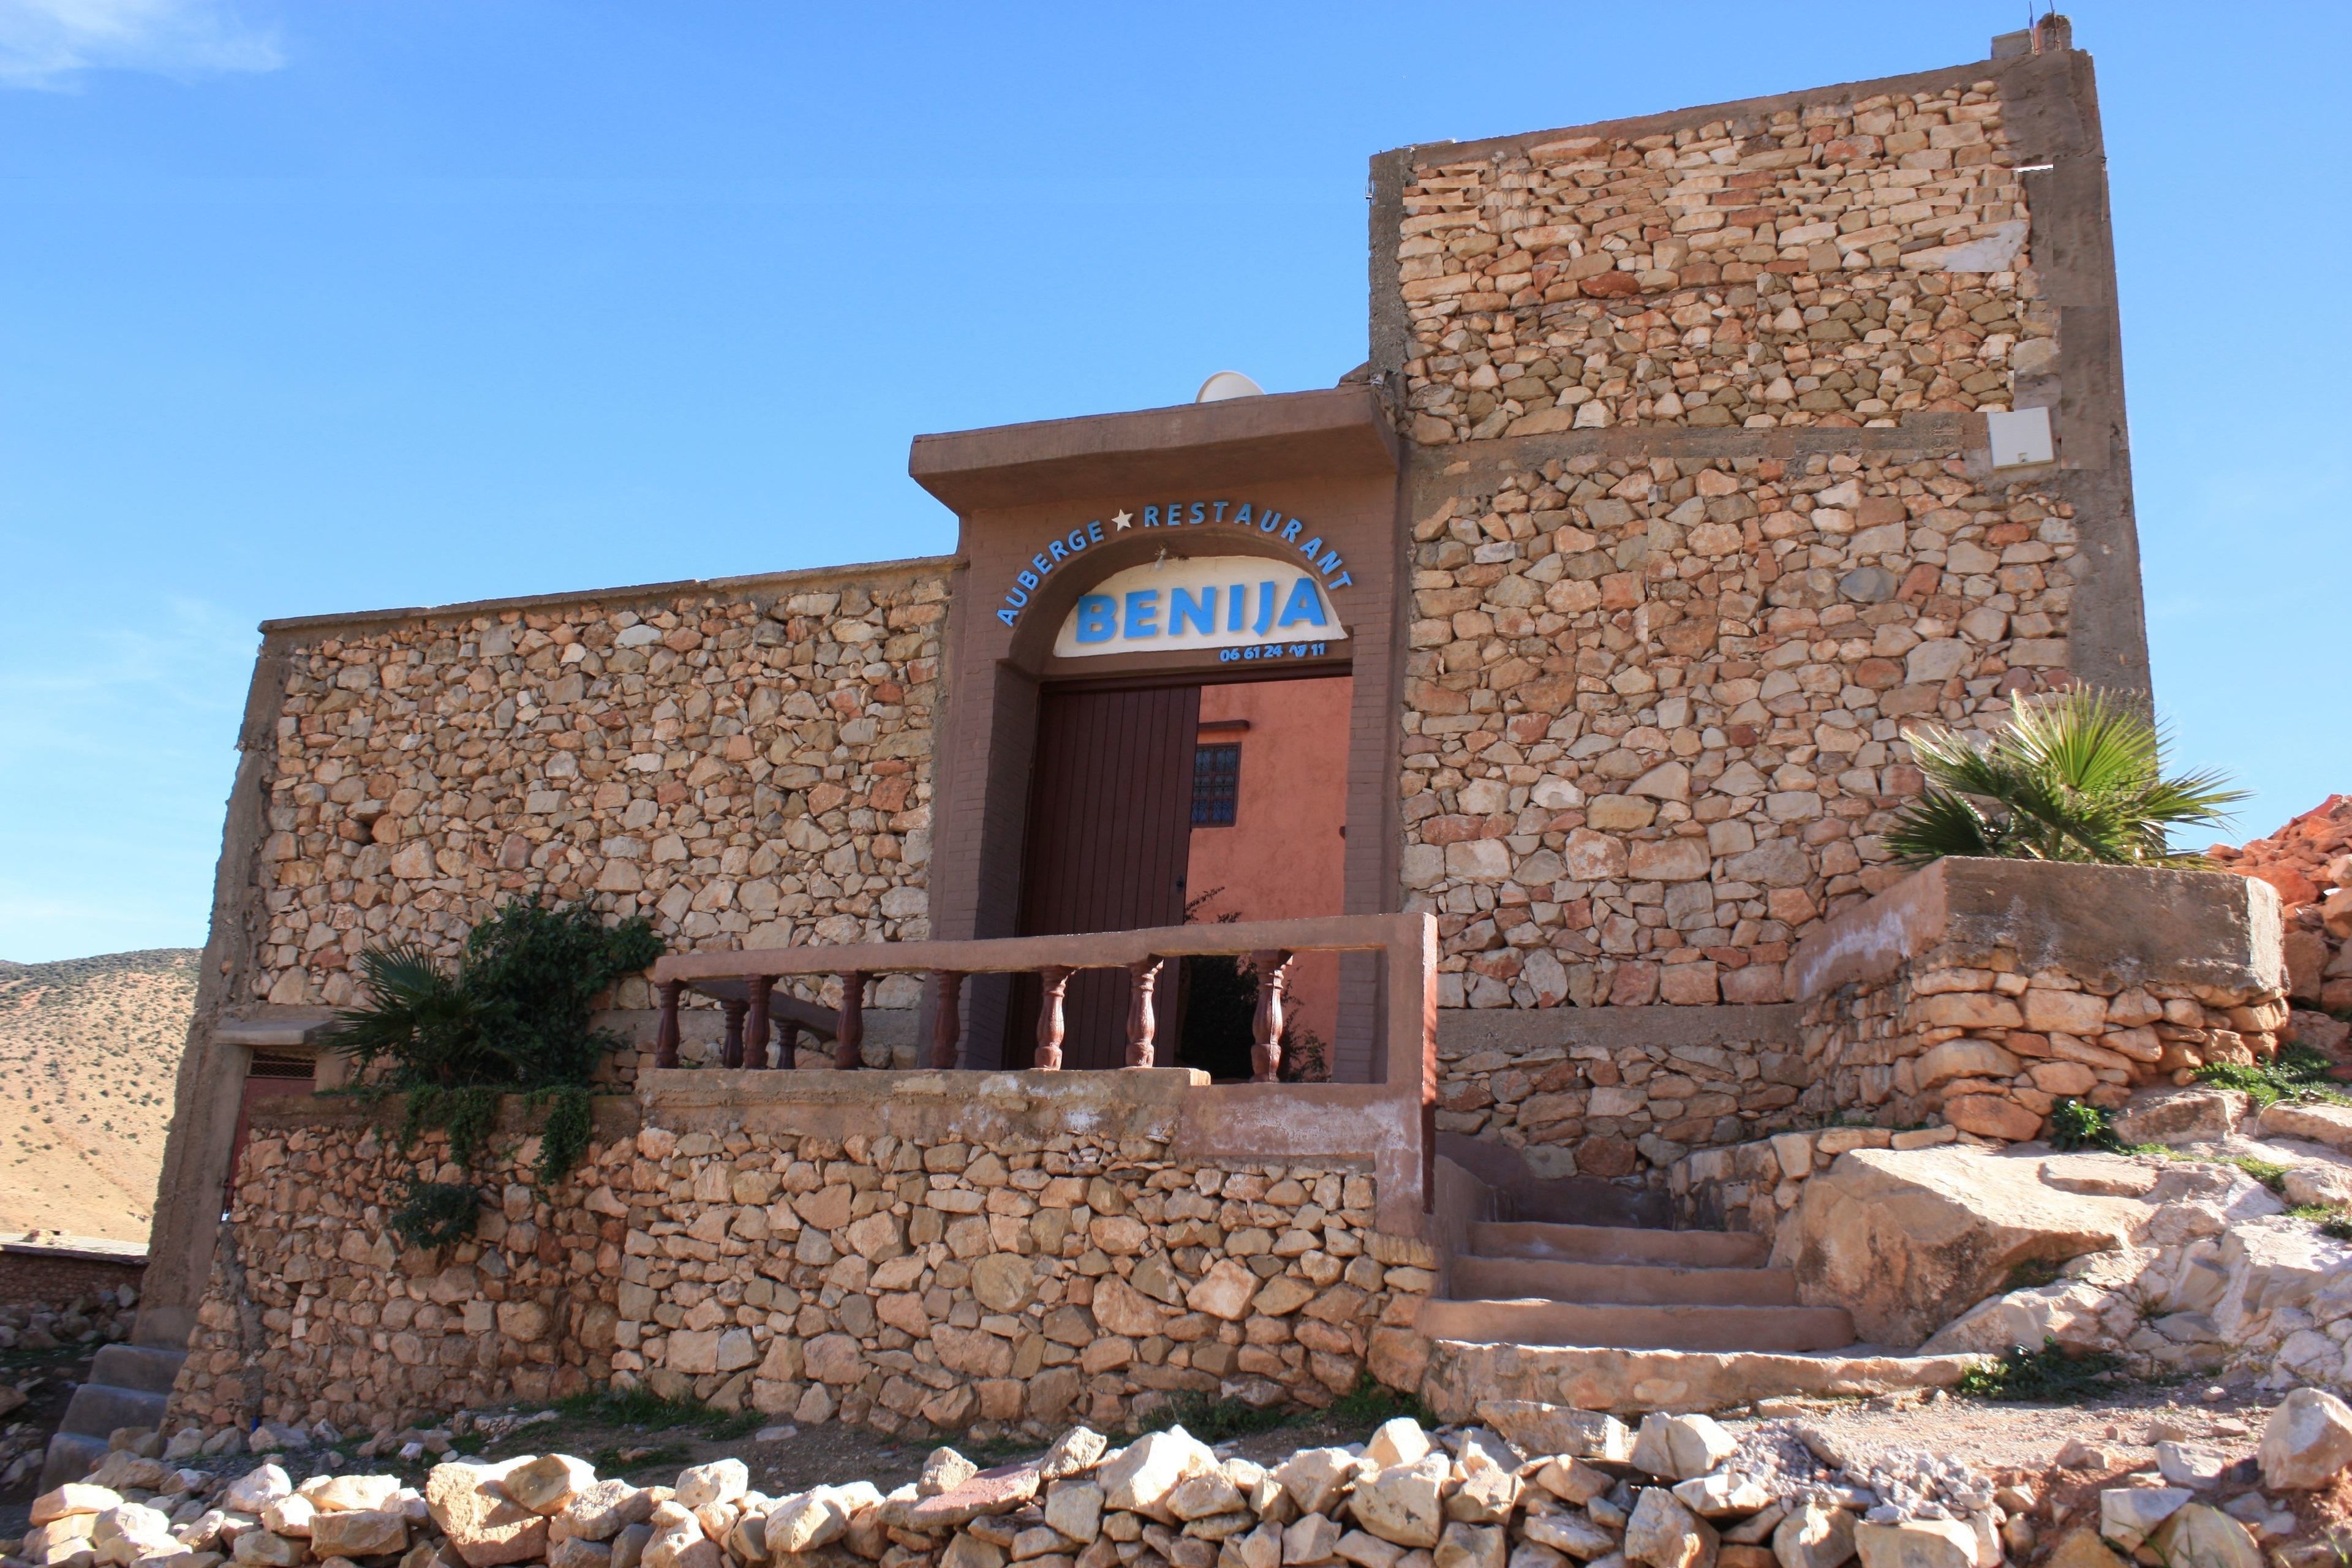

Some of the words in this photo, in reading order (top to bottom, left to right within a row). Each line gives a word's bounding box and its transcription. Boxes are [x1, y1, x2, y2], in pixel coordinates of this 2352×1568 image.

[997, 519, 1104, 627] AUBERGE
[1144, 501, 1352, 590] RESTAURANT
[1076, 577, 1327, 643] BENIJA
[1219, 648, 1241, 662] 06
[1243, 646, 1261, 660] 61
[1264, 644, 1283, 657] 24
[1311, 643, 1325, 656] 11
